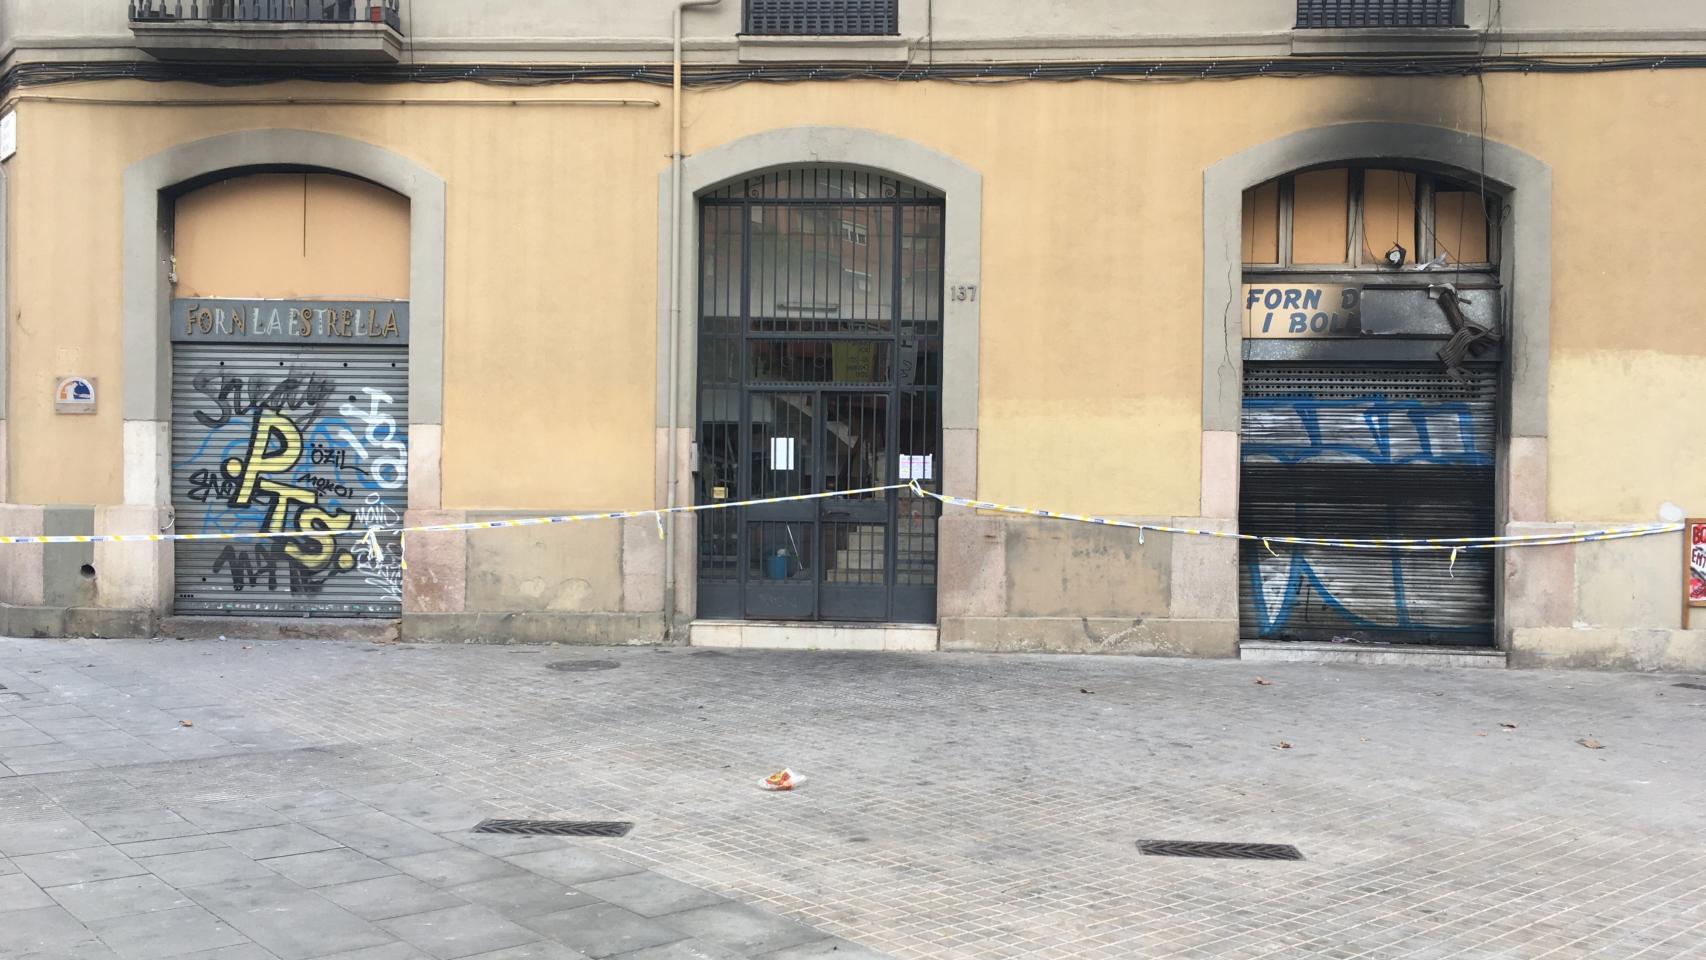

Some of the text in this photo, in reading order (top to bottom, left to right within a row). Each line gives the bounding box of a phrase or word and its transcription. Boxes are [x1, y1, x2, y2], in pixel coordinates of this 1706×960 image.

[950, 284, 977, 302] 137
[1246, 288, 1322, 310] FORN
[185, 304, 400, 337] FORN LA ESTRELLA
[1262, 312, 1273, 333] I
